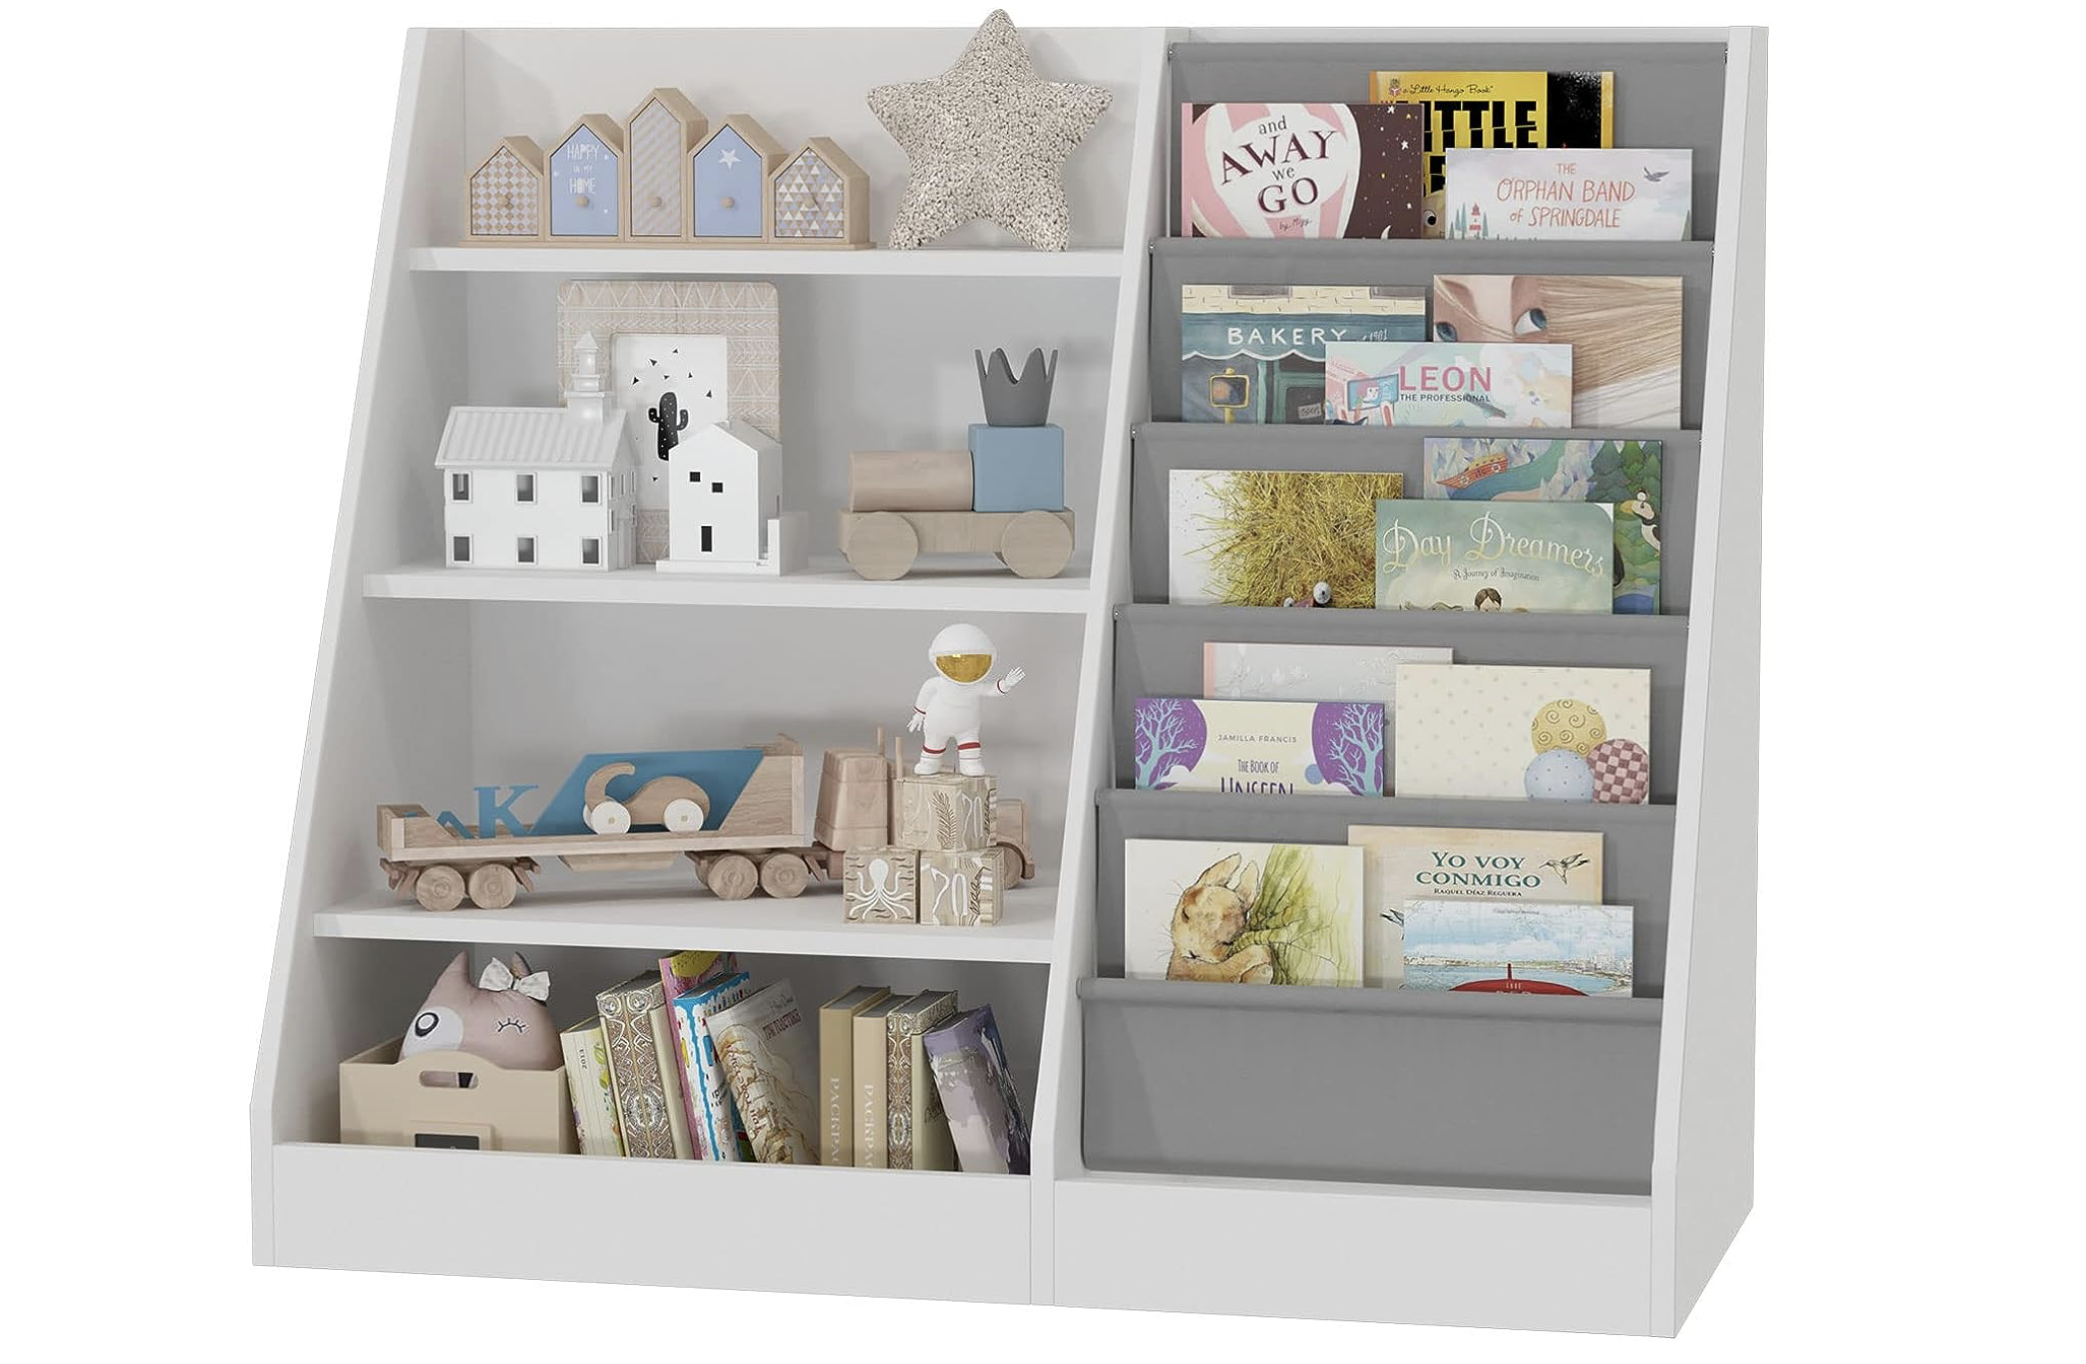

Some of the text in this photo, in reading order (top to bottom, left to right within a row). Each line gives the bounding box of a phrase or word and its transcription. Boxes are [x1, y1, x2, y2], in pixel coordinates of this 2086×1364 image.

[1409, 84, 1434, 95] Little
[1258, 115, 1287, 135] and
[1396, 101, 1539, 151] ITTLE
[566, 143, 599, 161] HAPPY
[1221, 130, 1337, 185] AWAY
[1272, 166, 1295, 181] we
[1556, 163, 1577, 175] THE
[569, 177, 596, 195] HOME
[1258, 177, 1318, 213] GO
[1497, 178, 1636, 203] ORPHAN BAND
[1509, 206, 1621, 228] of SPRINGDALE
[1227, 327, 1347, 345] BAKERY
[1400, 366, 1491, 392] LEON
[1400, 393, 1491, 402] THE PROFESSIONAL
[1382, 511, 1604, 577] Day Dreamers
[1218, 734, 1297, 743] JAMILLA FRANCIS
[1237, 759, 1280, 773] THE BOOK OF
[1475, 856, 1525, 870] VOY
[1416, 871, 1541, 888] CONMIGO
[1434, 888, 1464, 896] RAQUEL
[1487, 889, 1522, 897] REGUERA
